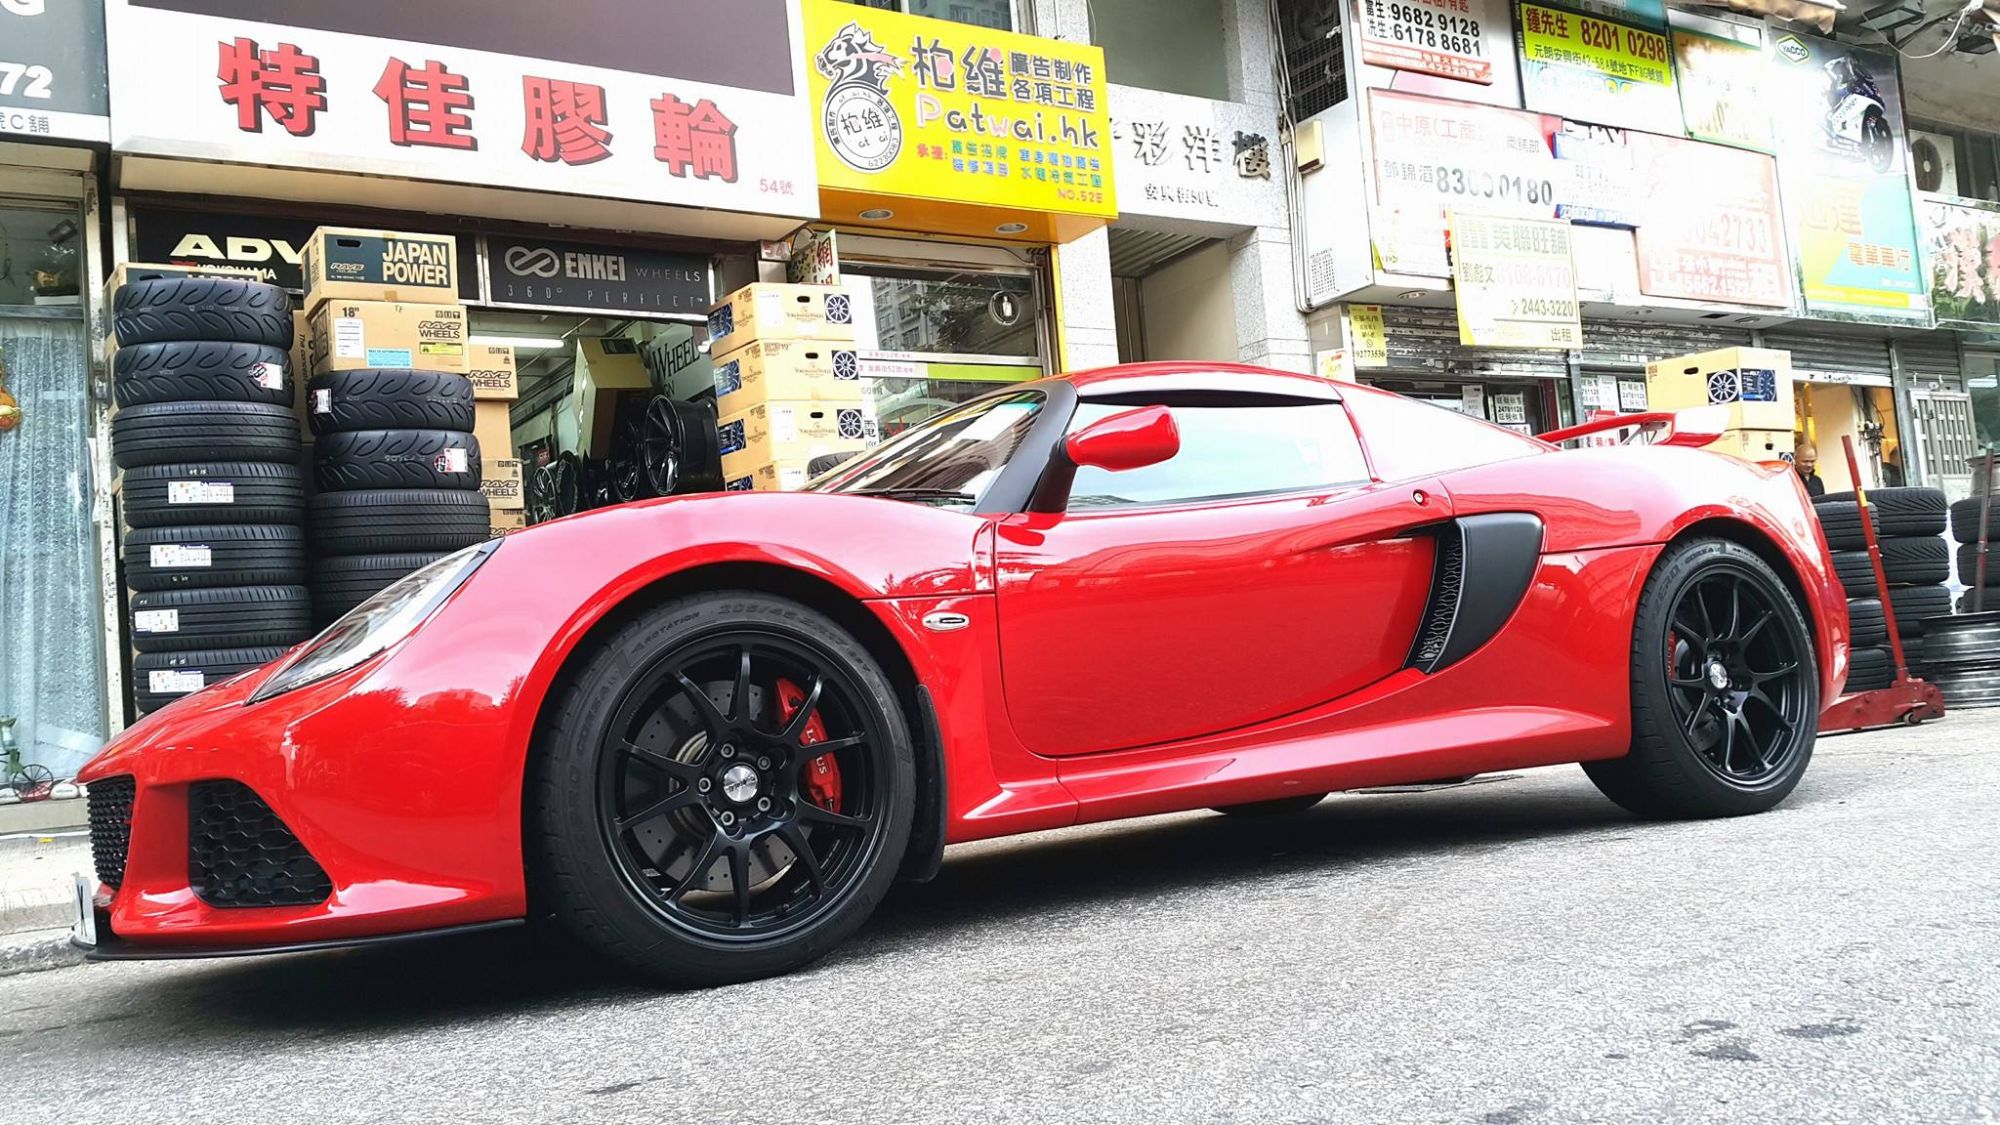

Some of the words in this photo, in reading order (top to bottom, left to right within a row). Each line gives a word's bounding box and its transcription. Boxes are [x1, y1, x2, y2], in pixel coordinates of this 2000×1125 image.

[1391, 3, 1434, 28] 9682
[1438, 14, 1480, 38] 9128
[1394, 23, 1436, 48] 6178
[1441, 33, 1481, 57] 8681
[1580, 19, 1620, 52] 8201
[1627, 30, 1666, 64] 0298
[1010, 52, 1092, 85] 廣告制作
[1012, 78, 1095, 111] 各項工程
[217, 36, 739, 184] 特佳膠輪
[915, 93, 1099, 148] Patwai.hk
[382, 241, 447, 266] JAPAN
[564, 251, 626, 283] ENKEI
[635, 267, 701, 283] WHEELS
[382, 262, 448, 286] POWER
[1521, 298, 1574, 318] 2443-3220
[418, 321, 462, 330] RAYS
[419, 329, 461, 339] WHEELS
[1550, 327, 1573, 343] 出租
[469, 370, 513, 379] RAYS
[480, 480, 519, 488] RAYS
